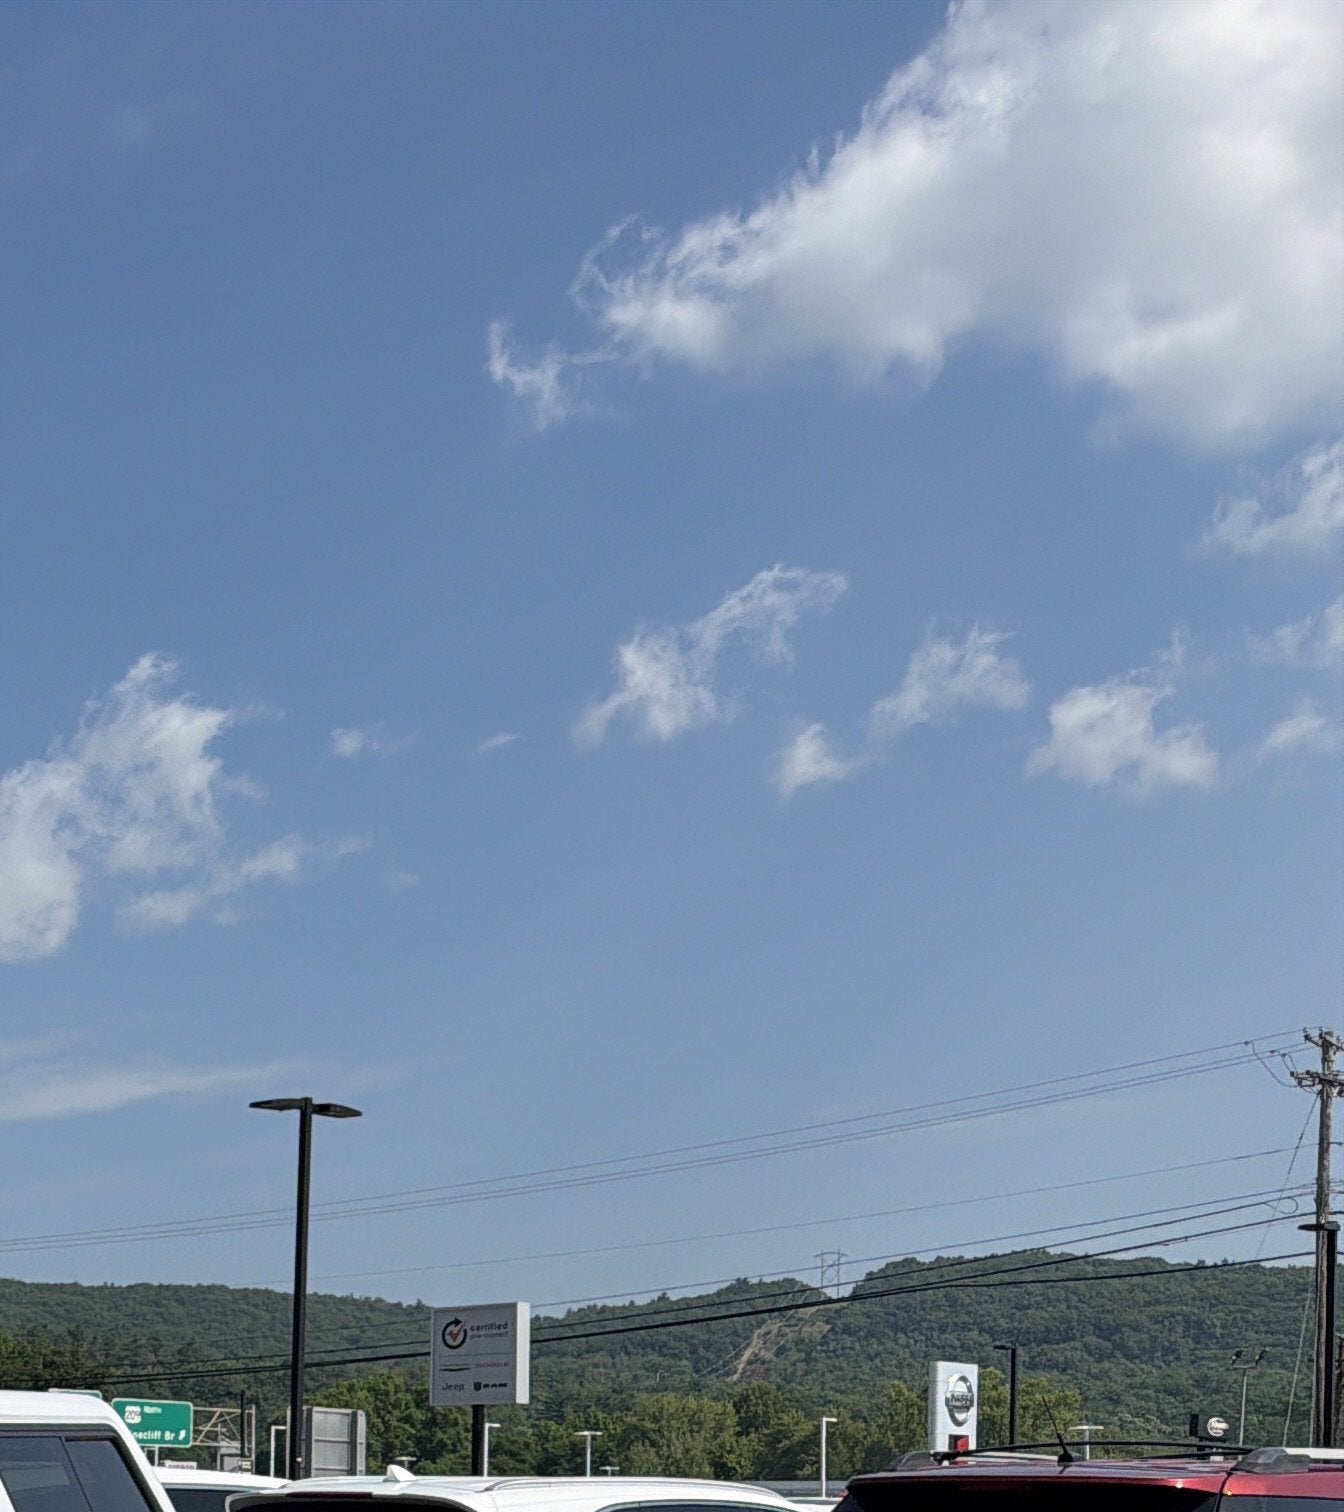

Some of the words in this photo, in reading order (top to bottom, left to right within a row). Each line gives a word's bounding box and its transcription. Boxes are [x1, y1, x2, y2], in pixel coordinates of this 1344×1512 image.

[469, 1321, 509, 1332] certified
[442, 1383, 465, 1392] Jeep
[482, 1382, 509, 1390] RAM
[164, 1430, 176, 1441] Br
